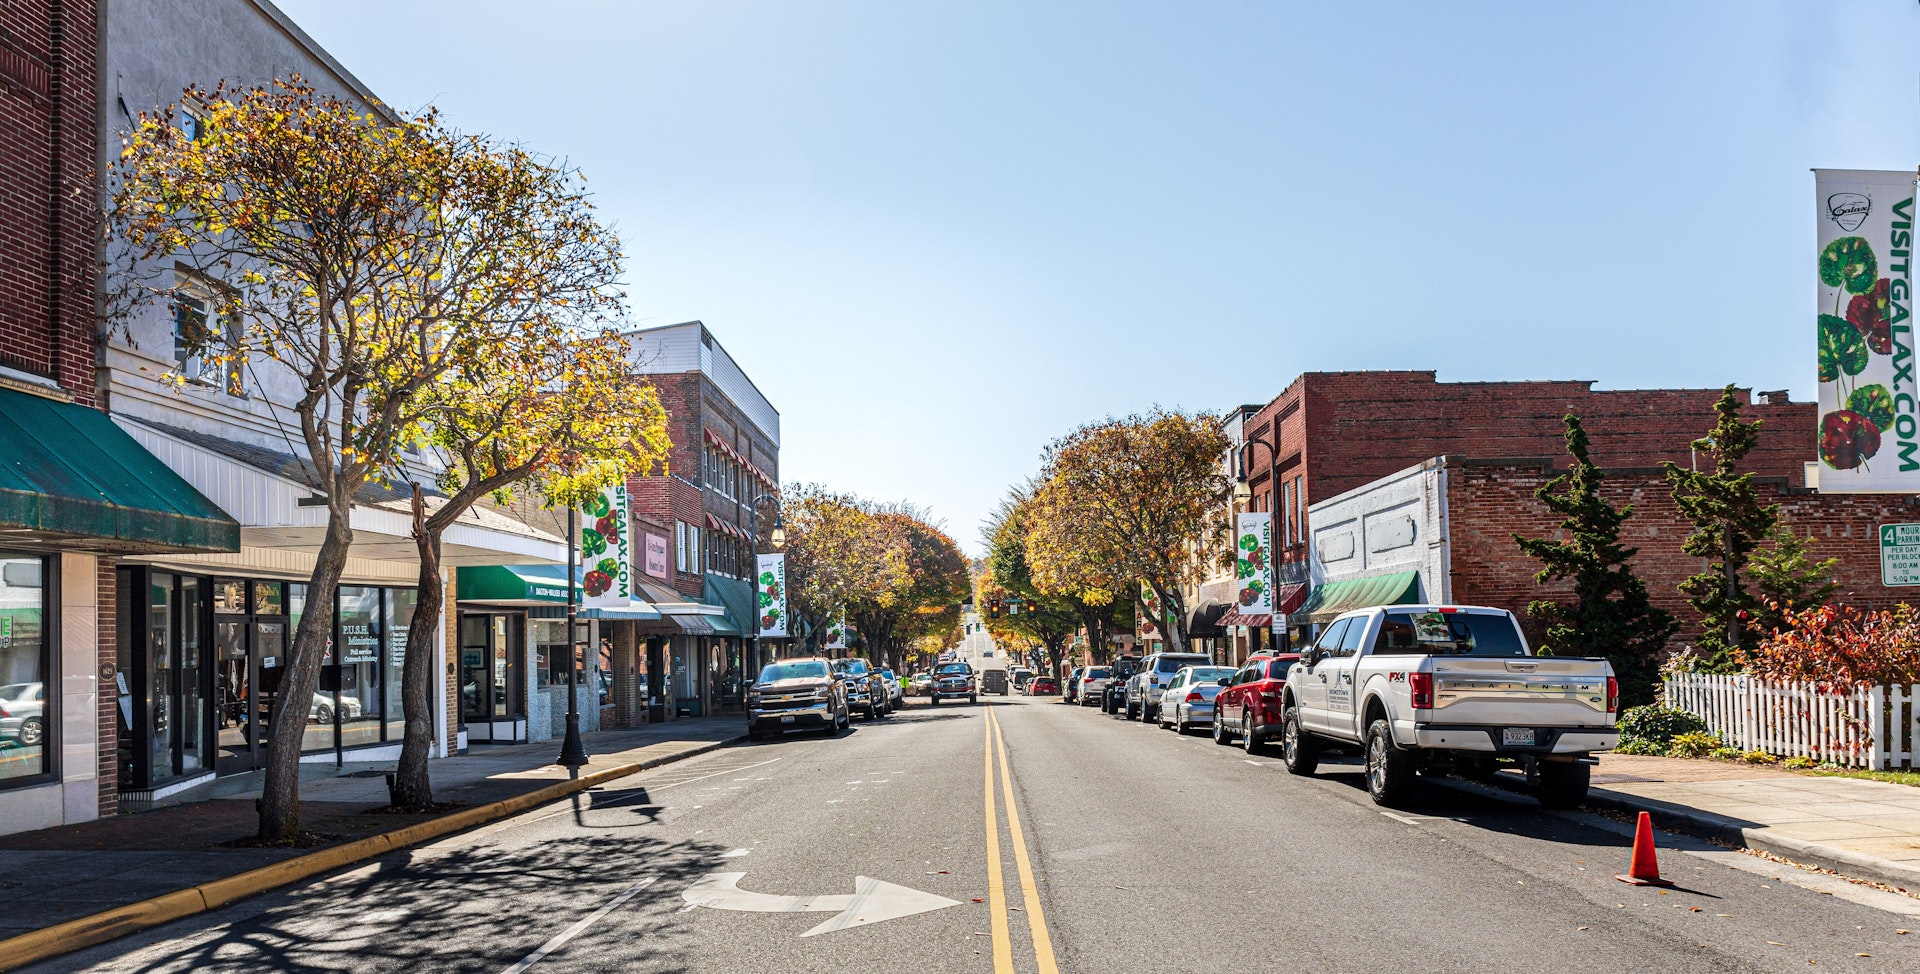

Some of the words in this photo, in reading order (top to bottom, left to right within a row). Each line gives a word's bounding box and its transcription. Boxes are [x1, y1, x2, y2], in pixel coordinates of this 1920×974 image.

[1890, 197, 1920, 472] VISITGALAX.COM
[616, 482, 629, 598] SITGALAX.COM
[1884, 529, 1895, 544] 4
[1897, 535, 1920, 543] PARKIN
[1263, 520, 1271, 607] VISITGALAX.COM
[1893, 575, 1908, 583] 5:00
[342, 625, 369, 634] P.U.S.H.
[348, 636, 379, 645] Ministries
[1389, 671, 1405, 682] FX4
[1453, 682, 1589, 690] PLATINUM
